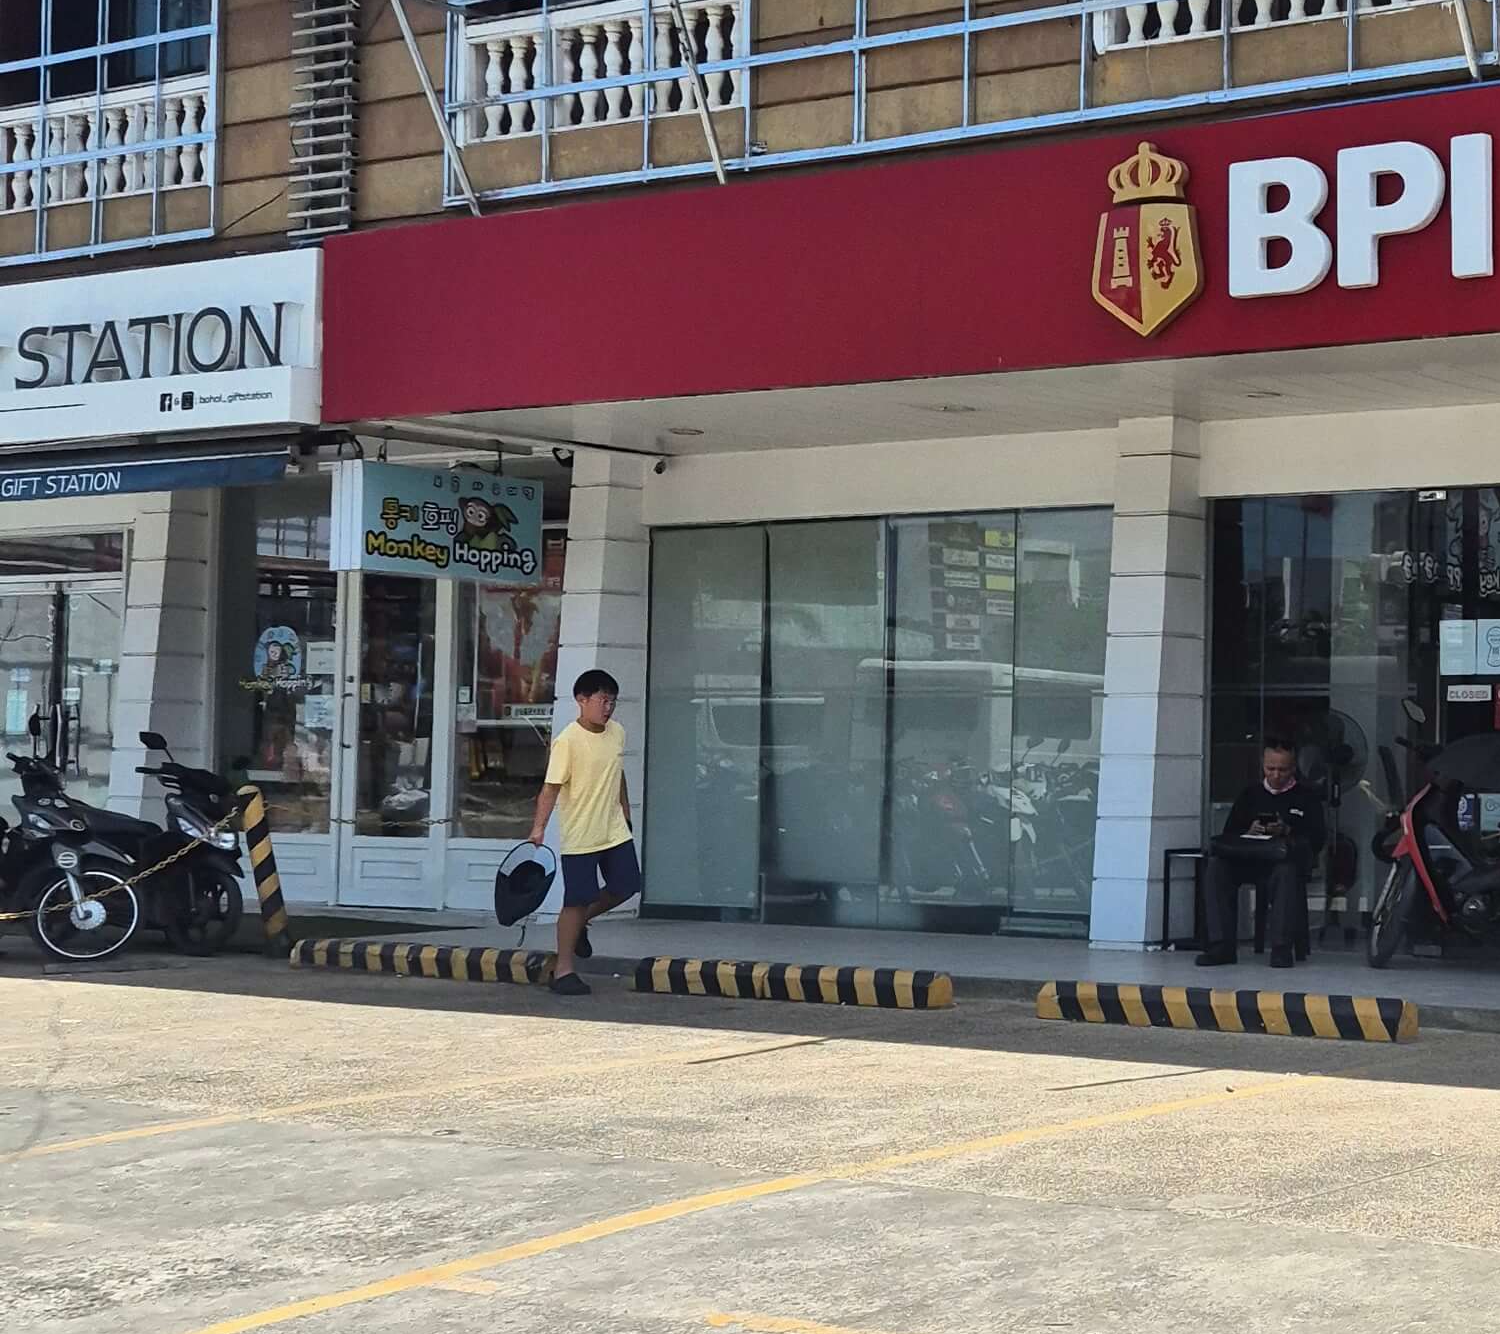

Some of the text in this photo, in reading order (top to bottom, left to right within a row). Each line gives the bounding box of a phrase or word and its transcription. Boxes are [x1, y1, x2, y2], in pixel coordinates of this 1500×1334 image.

[1229, 132, 1494, 299] BPI
[15, 301, 286, 390] STATION
[1, 470, 122, 498] GIFT STATION
[421, 501, 460, 536] 호핑
[366, 531, 537, 573] Monkey Hopping
[1448, 689, 1489, 700] CLOSED
